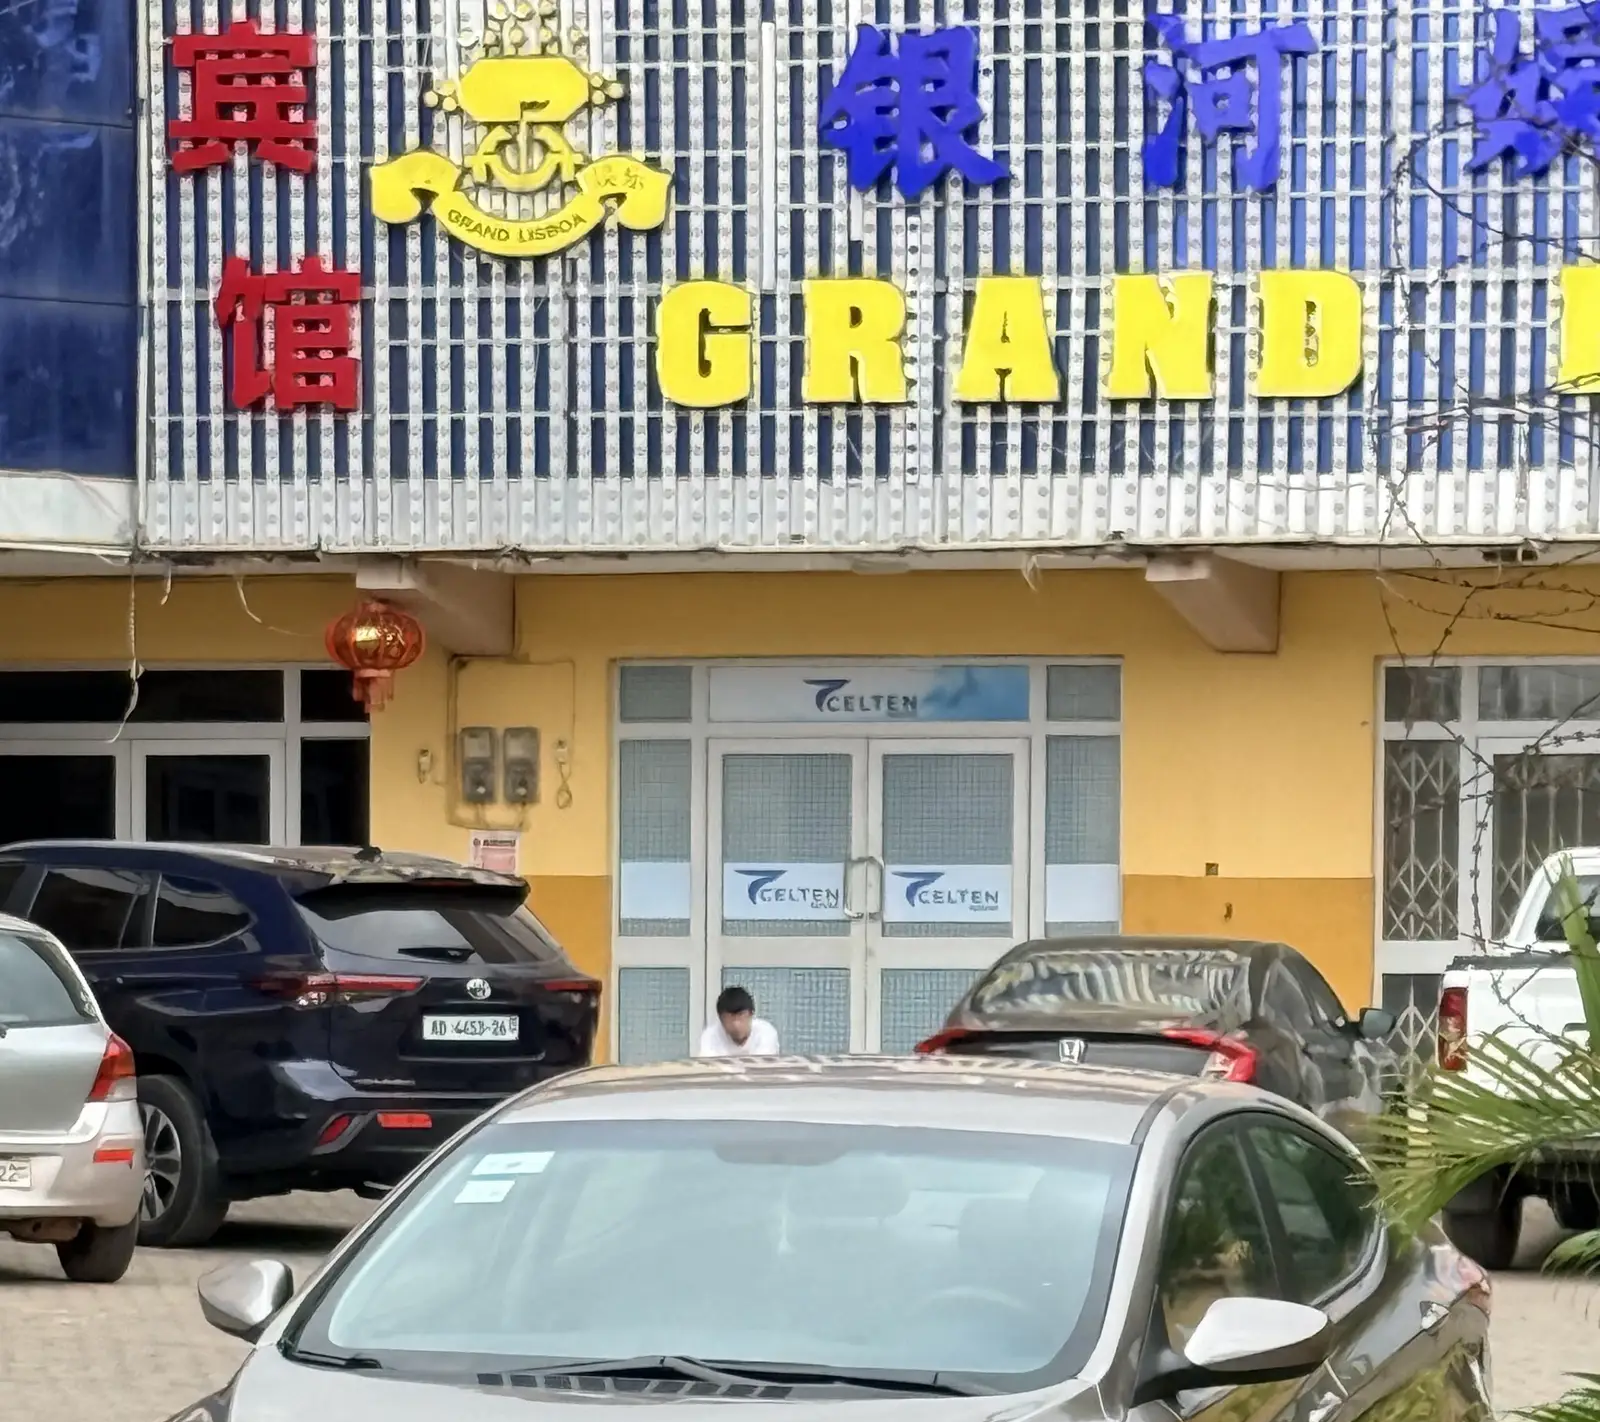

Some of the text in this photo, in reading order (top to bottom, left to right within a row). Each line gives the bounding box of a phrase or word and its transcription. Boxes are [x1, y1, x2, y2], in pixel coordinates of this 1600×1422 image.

[168, 19, 362, 412] 宾馆
[447, 208, 510, 242] GRAND
[656, 270, 1363, 408] GRAND
[826, 695, 918, 712] CELTEN
[760, 888, 839, 904] CELTEN
[918, 889, 999, 904] CELTEN
